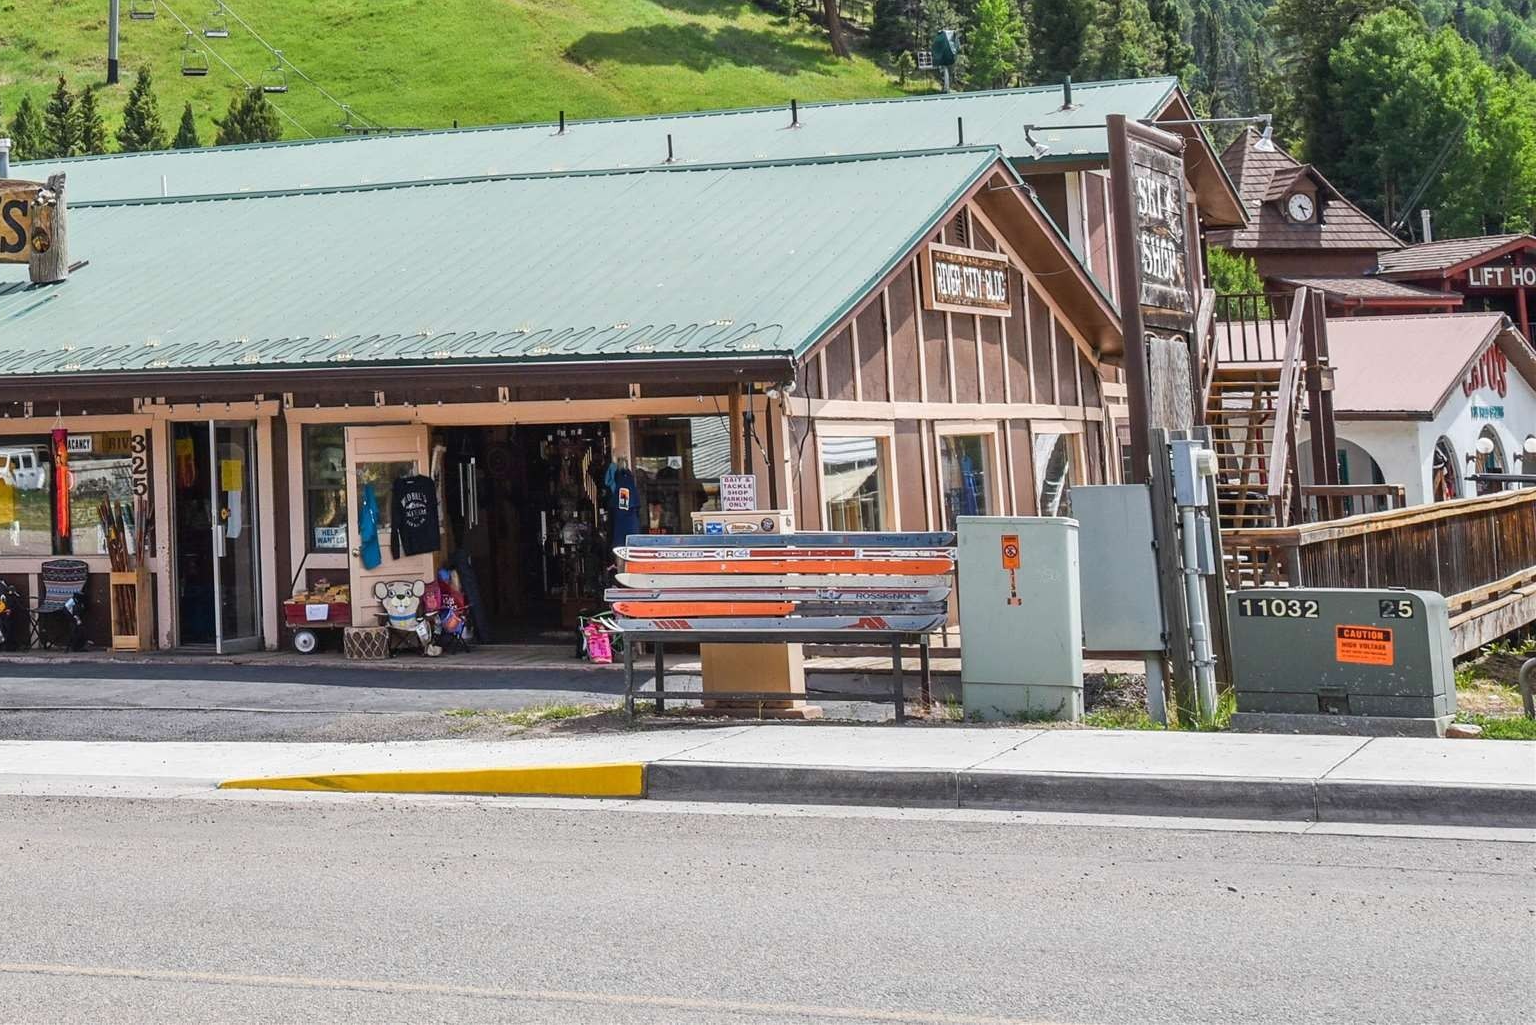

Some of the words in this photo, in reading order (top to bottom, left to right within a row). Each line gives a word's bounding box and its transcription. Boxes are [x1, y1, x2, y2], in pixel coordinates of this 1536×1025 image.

[1141, 232, 1176, 279] SHOP
[963, 266, 982, 298] CITY
[1469, 267, 1504, 286] LIFT
[67, 438, 91, 450] ACANCY
[317, 536, 345, 544] WANTED
[856, 592, 913, 600] ROSSIGNOL
[1242, 600, 1319, 618] 11032
[1343, 629, 1384, 640] CAUTION
